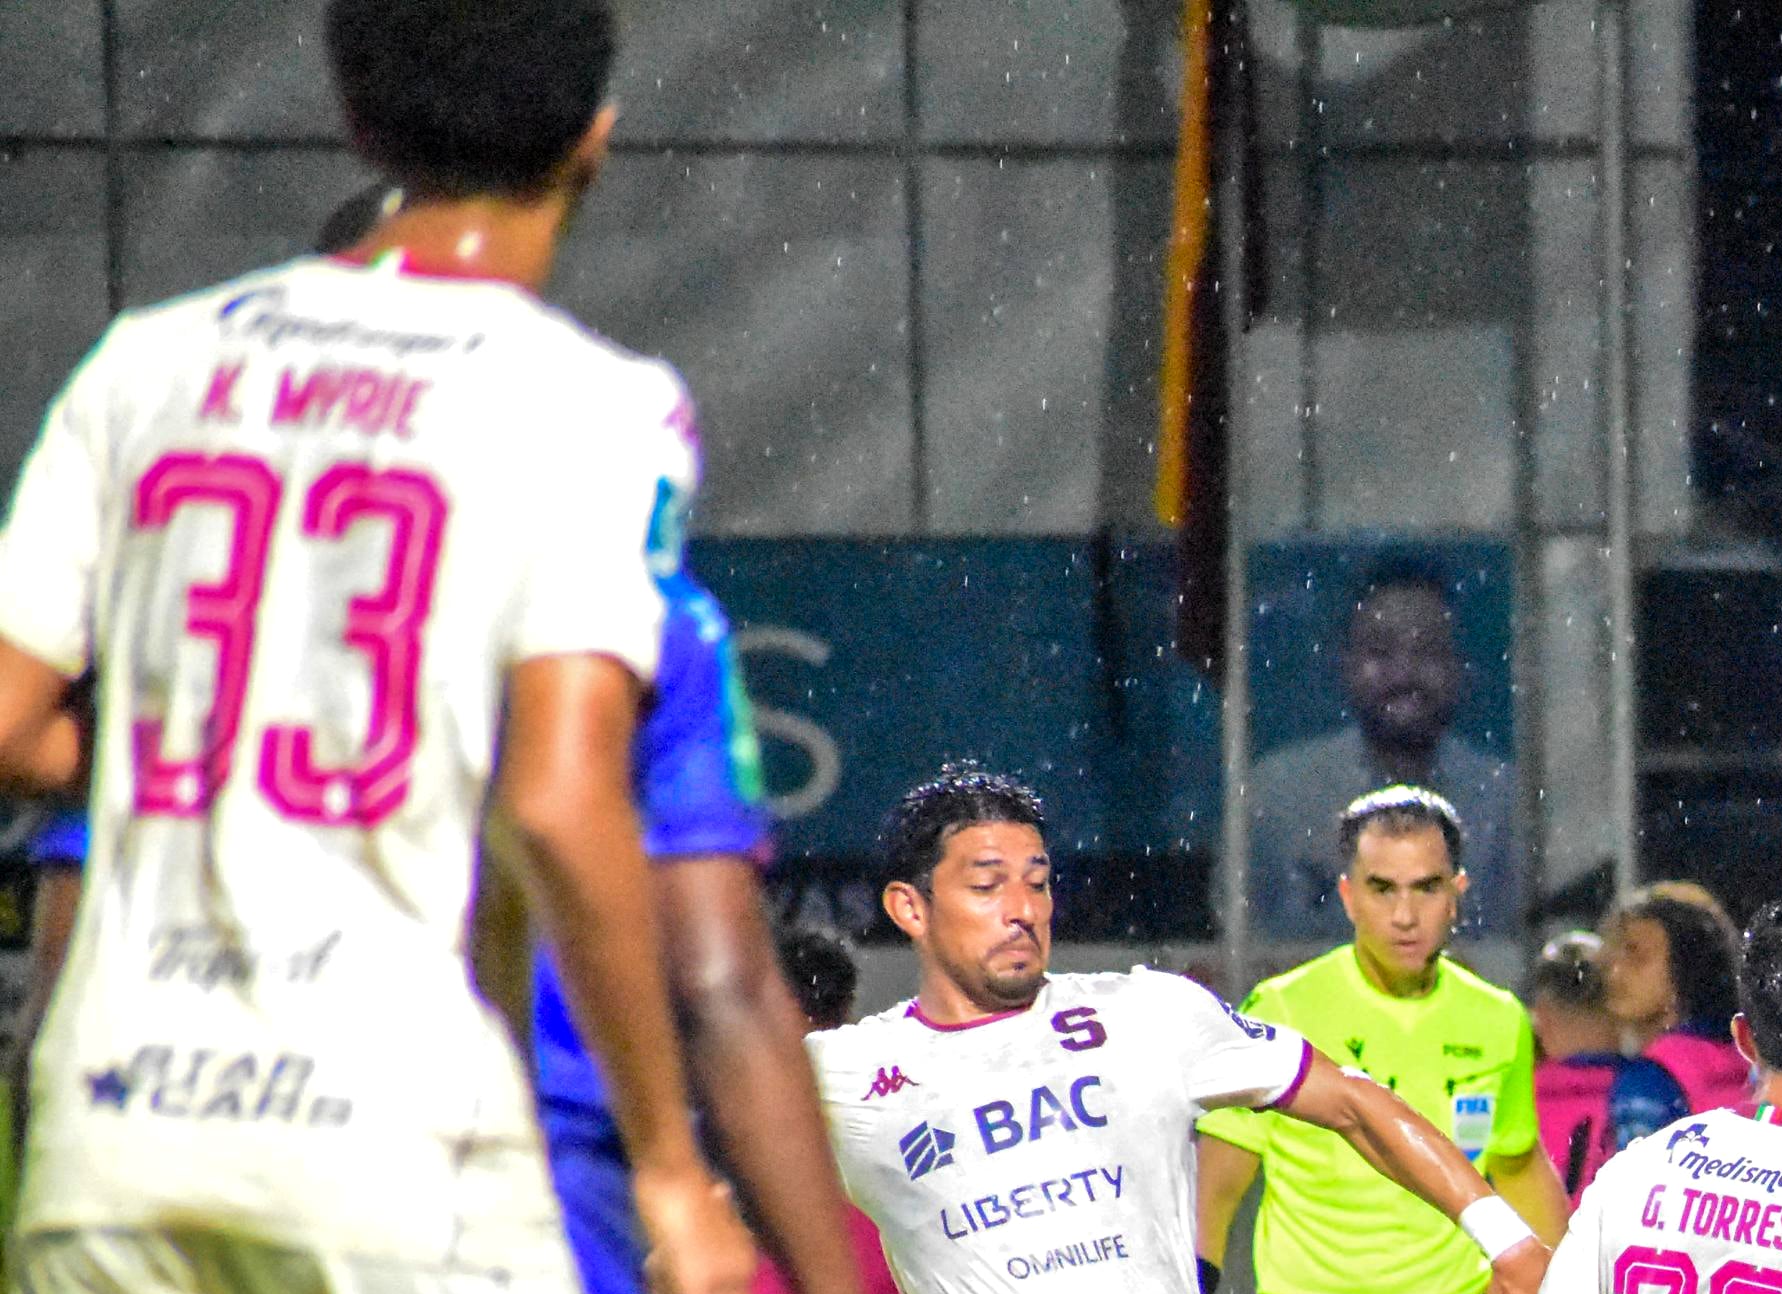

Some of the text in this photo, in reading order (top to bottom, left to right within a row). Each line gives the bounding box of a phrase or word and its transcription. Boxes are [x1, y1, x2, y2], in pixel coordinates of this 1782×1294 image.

[132, 451, 448, 827] 33
[973, 1075, 1107, 1155] BAC
[941, 1165, 1124, 1241] LIBERTY
[1641, 1184, 1667, 1230] G.
[1007, 1234, 1129, 1280] OMNILIFE
